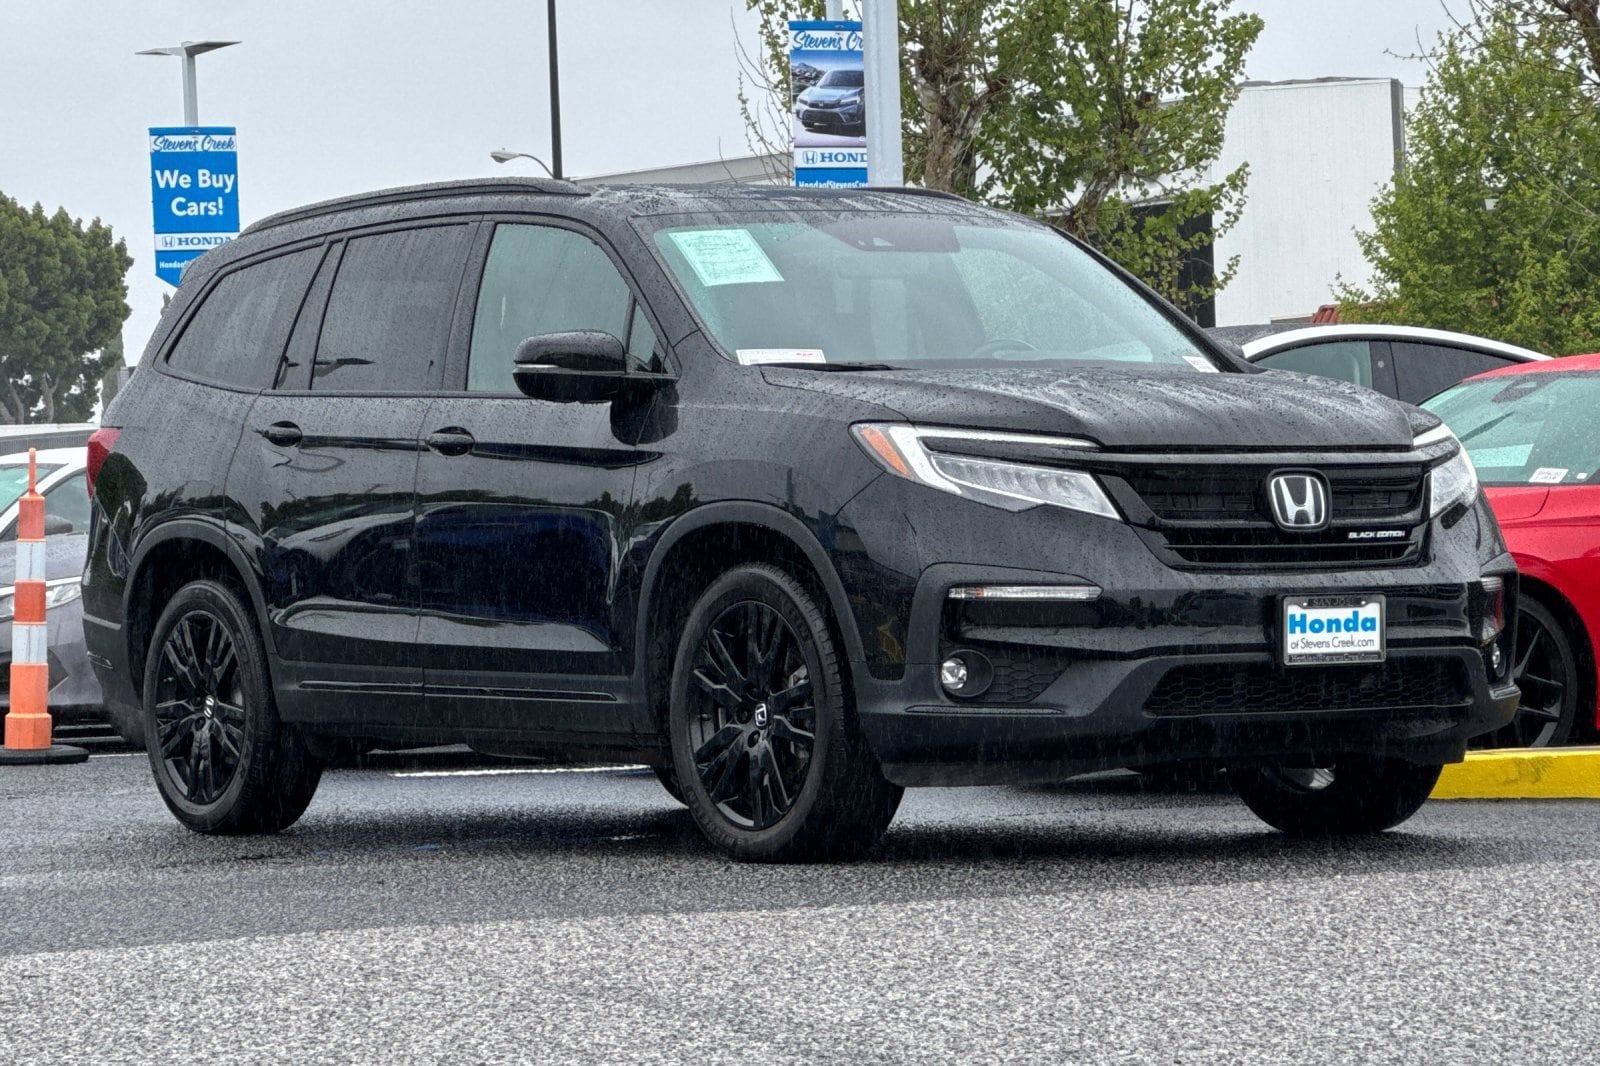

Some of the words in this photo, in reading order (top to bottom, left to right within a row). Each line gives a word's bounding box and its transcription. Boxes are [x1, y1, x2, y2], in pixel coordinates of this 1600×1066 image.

[792, 30, 843, 50] Stevens
[152, 135, 199, 152] Stevens
[201, 135, 235, 152] Creek
[154, 169, 192, 189] We
[197, 169, 235, 194] Buy
[171, 197, 224, 216] Cars!
[1348, 531, 1375, 539] BLACK
[1376, 530, 1405, 538] EDITION
[1289, 610, 1376, 634] Honda
[1290, 638, 1299, 650] of
[1300, 637, 1330, 649] Stevens
[1331, 634, 1375, 648] Creek.com
